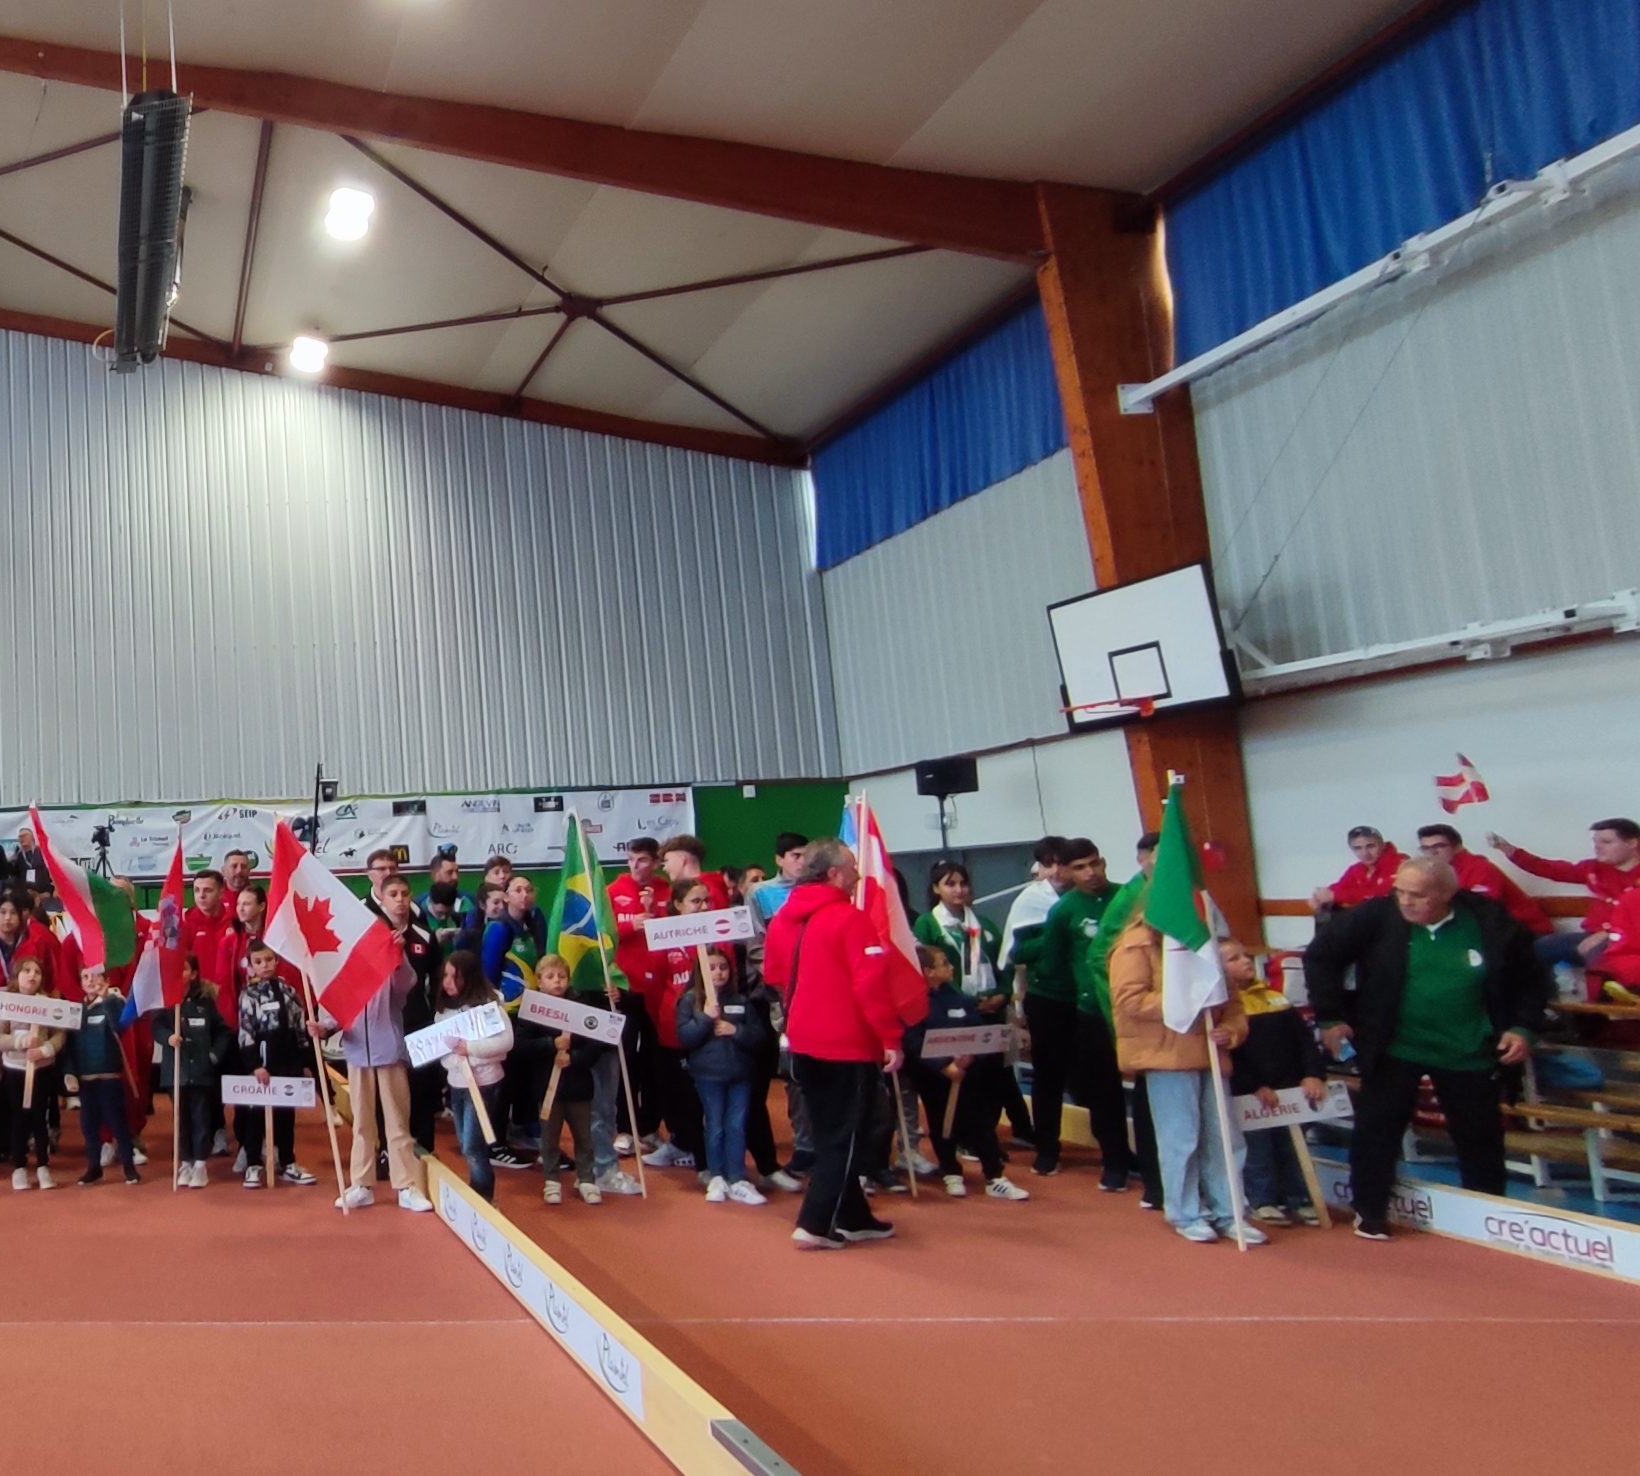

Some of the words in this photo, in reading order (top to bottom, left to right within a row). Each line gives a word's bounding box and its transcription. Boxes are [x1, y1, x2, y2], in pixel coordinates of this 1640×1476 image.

[653, 925, 709, 941] AUTRICHE
[0, 1002, 48, 1017] HONGRIE
[529, 1003, 570, 1023] BRESIL
[232, 1084, 278, 1096] CROATIE
[1244, 1102, 1301, 1121] ALGERIE
